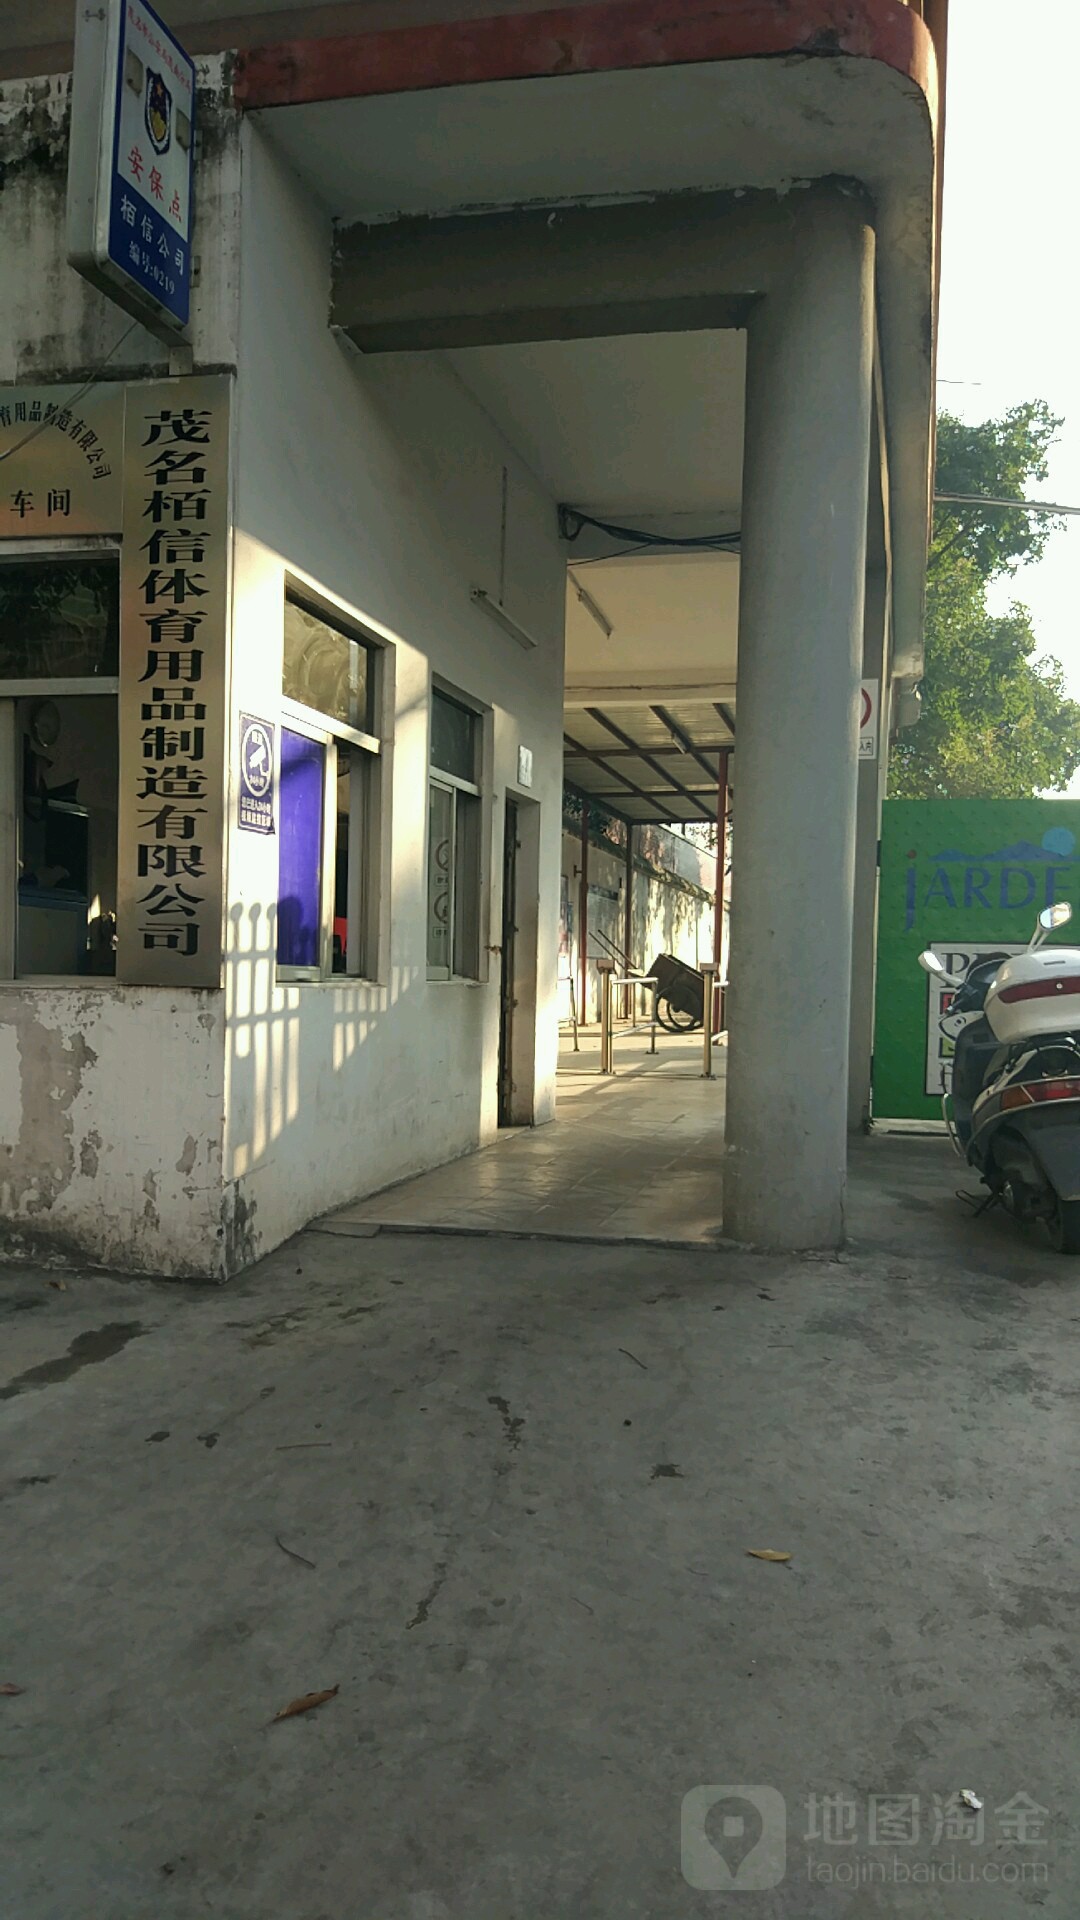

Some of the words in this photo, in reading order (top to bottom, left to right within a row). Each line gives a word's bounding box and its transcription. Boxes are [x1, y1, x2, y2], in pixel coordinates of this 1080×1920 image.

[128, 146, 182, 223] 安保点
[10, 489, 71, 518] 车间
